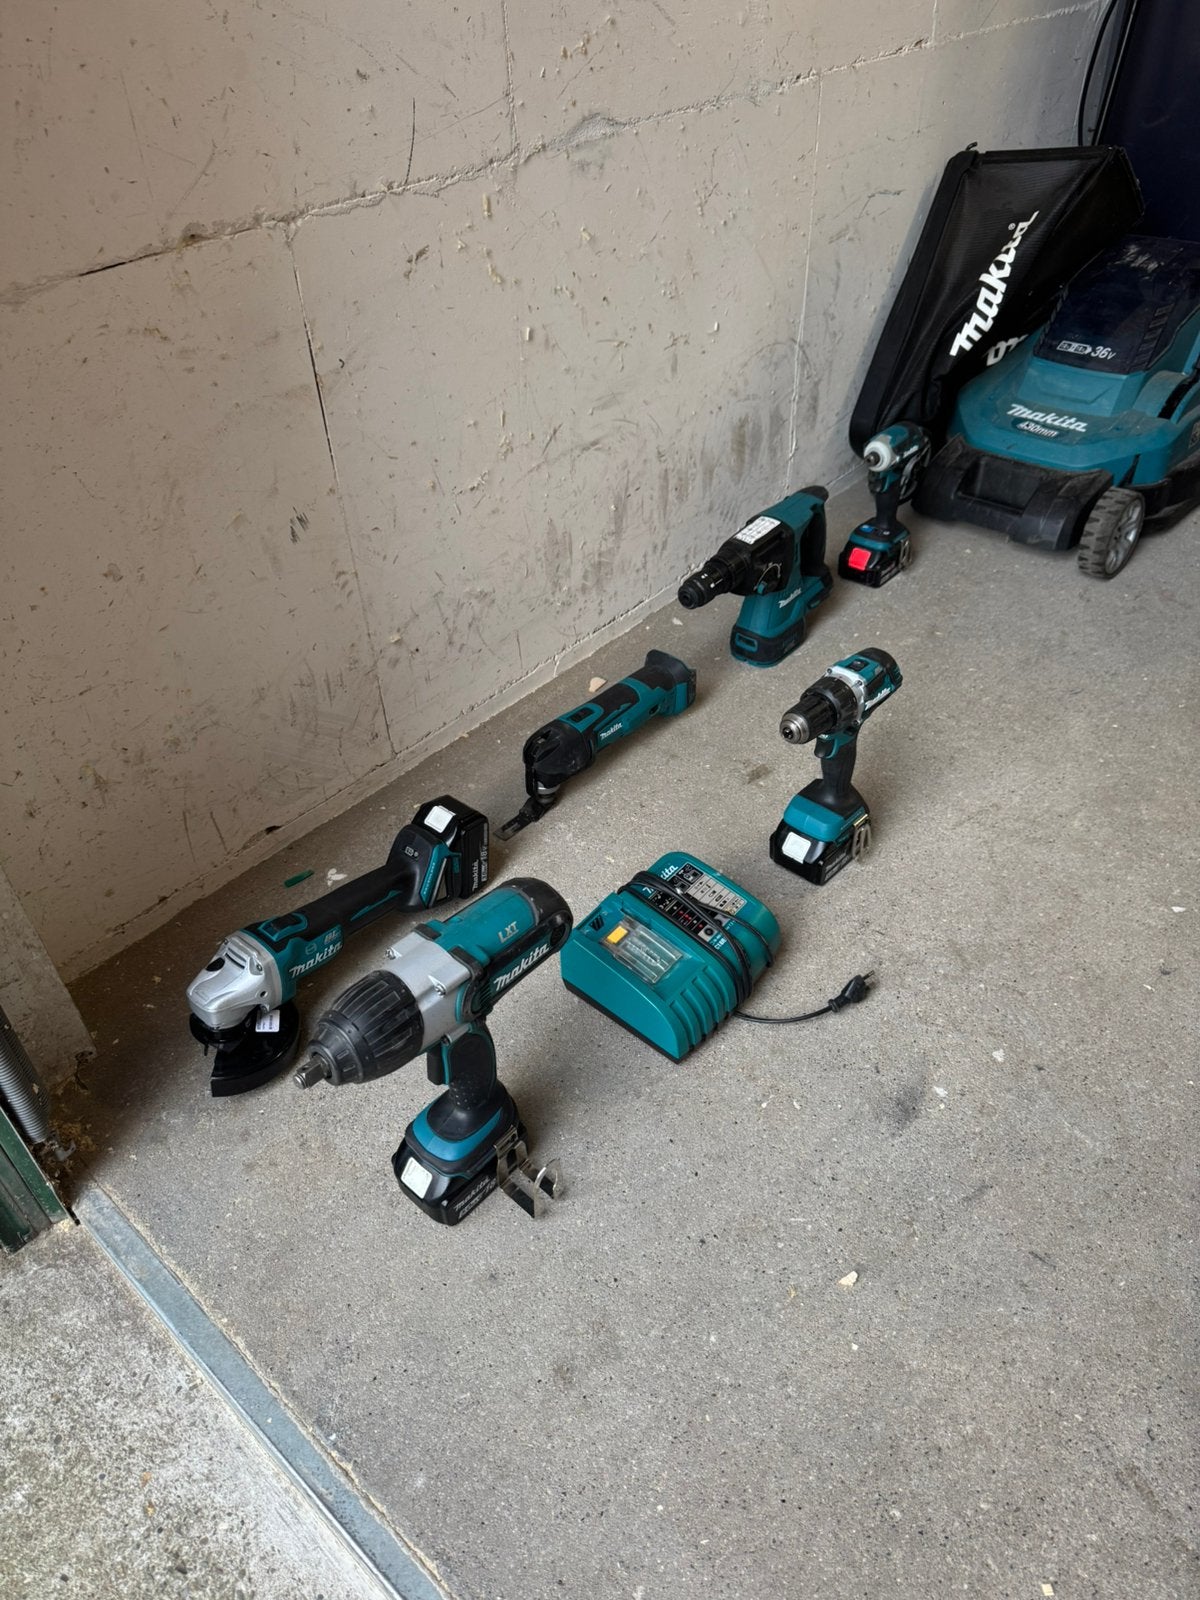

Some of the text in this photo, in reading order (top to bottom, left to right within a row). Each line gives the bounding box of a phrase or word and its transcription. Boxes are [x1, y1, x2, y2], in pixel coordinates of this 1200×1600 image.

[1006, 403, 1088, 432] makita
[498, 920, 519, 943] LXT
[289, 942, 343, 979] makita
[493, 943, 550, 992] makita
